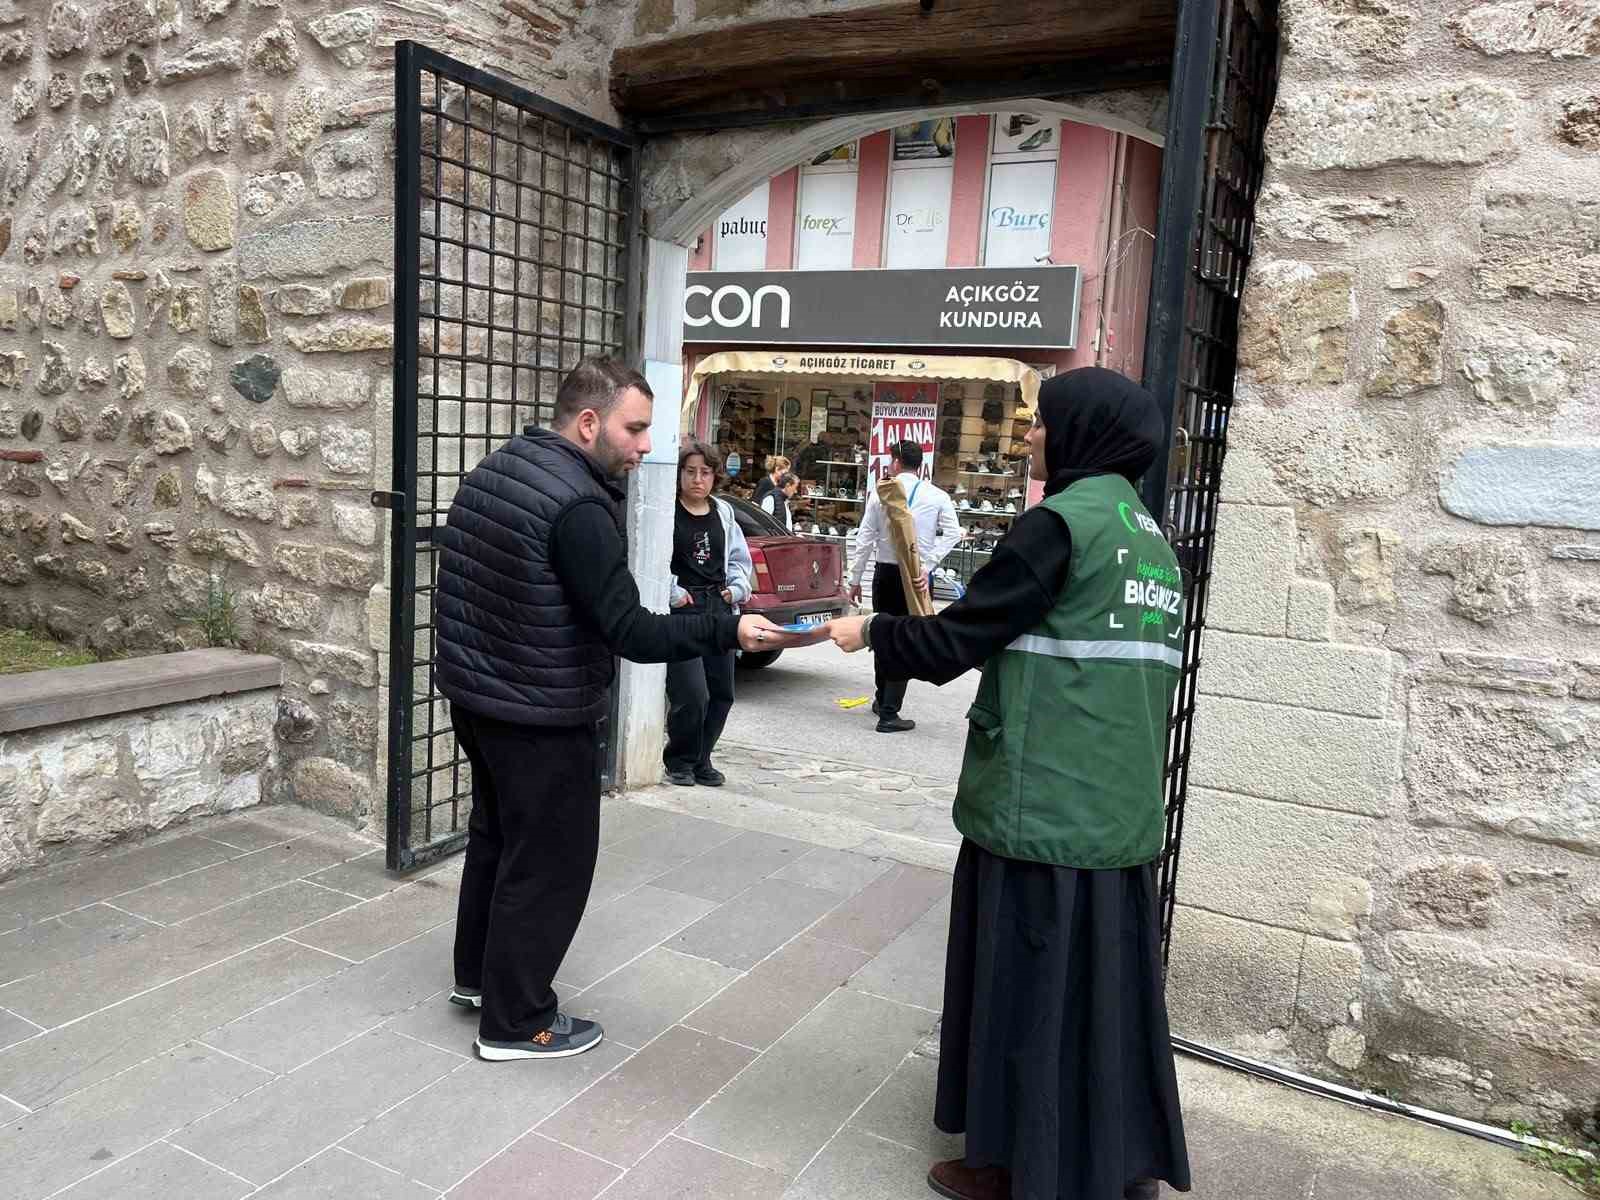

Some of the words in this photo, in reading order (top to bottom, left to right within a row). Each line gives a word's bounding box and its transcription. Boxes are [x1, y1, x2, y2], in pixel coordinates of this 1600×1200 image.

[720, 216, 768, 239] pabuç
[945, 280, 1040, 307] AÇIKGÖZ
[939, 310, 1043, 329] KUNDURA
[799, 355, 847, 370] AÇIKGÖZ
[849, 356, 896, 370] TİCARET
[898, 405, 936, 418] KAMPANYA
[872, 418, 885, 454] 1
[886, 421, 933, 447] ALANA
